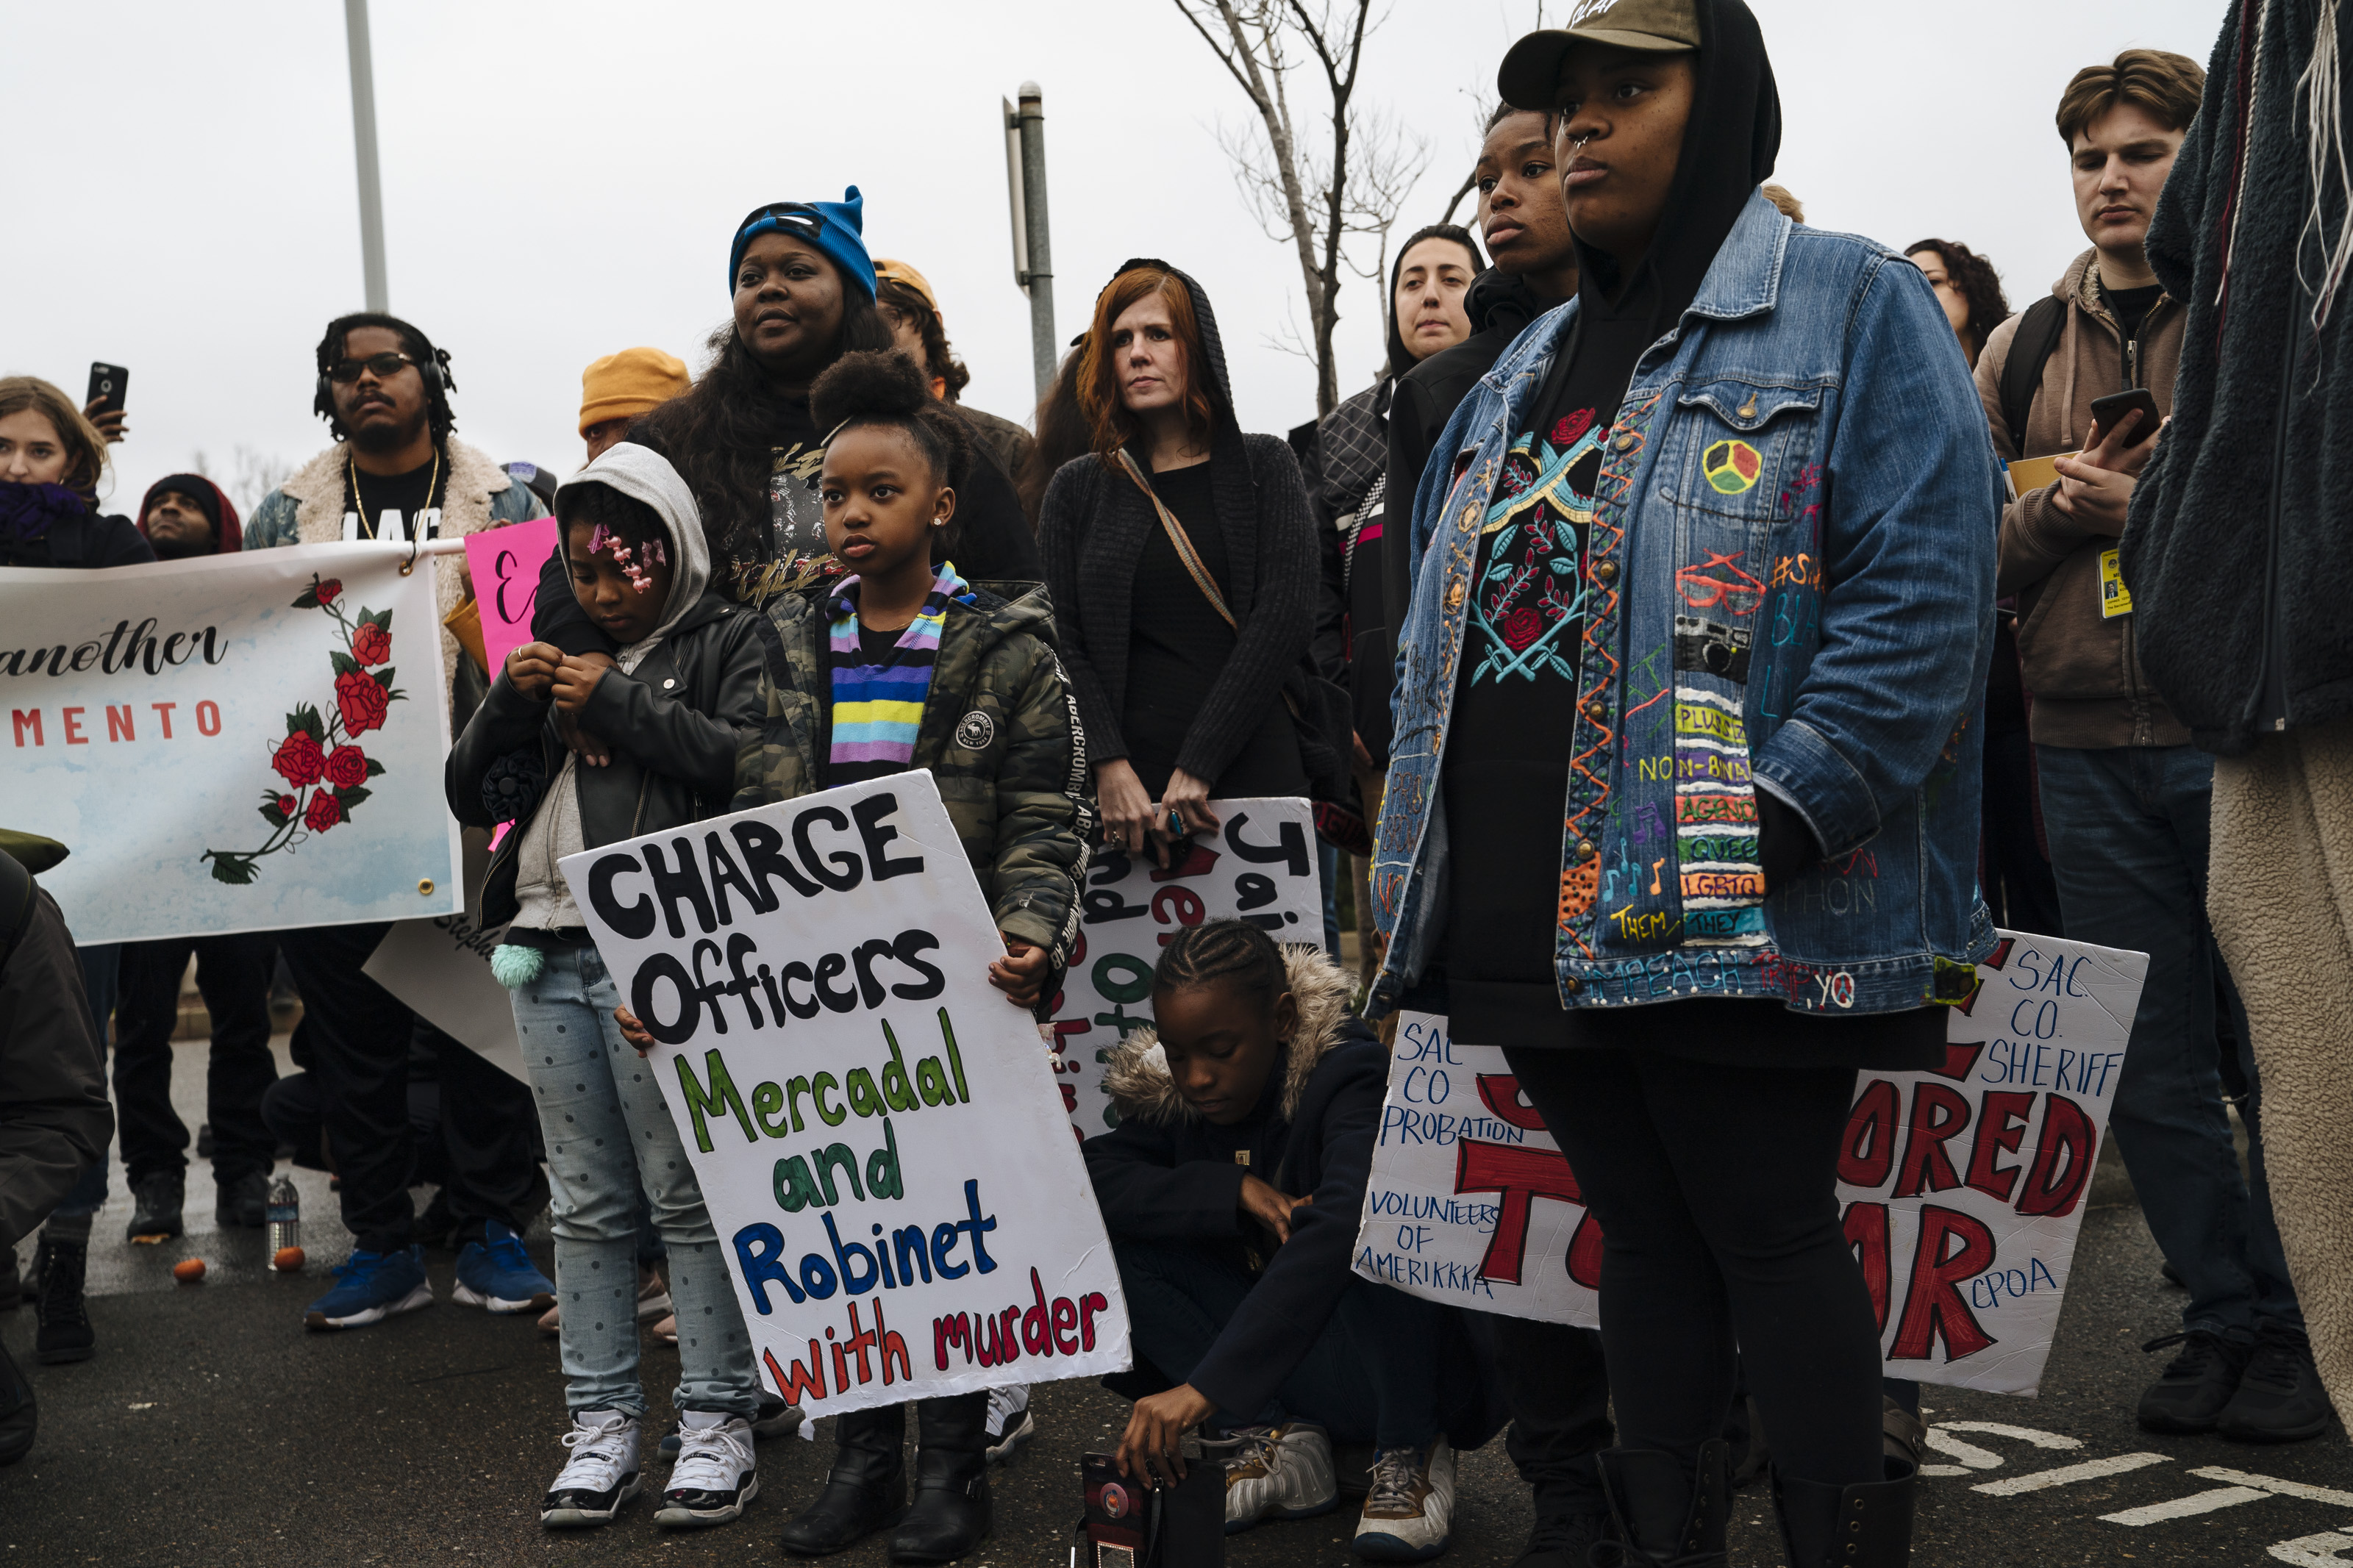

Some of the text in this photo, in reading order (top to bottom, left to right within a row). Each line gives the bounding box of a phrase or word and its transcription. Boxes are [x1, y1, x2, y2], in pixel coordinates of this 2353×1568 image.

[0, 617, 228, 677] another
[12, 700, 222, 748] MENTO
[588, 792, 924, 939] CHARGE
[1224, 812, 1318, 955] Jai
[1685, 875, 1757, 900] LGBTQ
[1610, 904, 1666, 942] THEM
[1689, 911, 1741, 933] THEY
[632, 929, 946, 1045] Officers
[1583, 950, 1744, 1006] IMPEACH
[2011, 999, 2063, 1039] CO.
[674, 1007, 970, 1153] Mercadal
[1404, 1066, 1450, 1104] CO
[1981, 1038, 2124, 1098] SHERIFF
[1380, 1105, 1524, 1146] PROBATION
[772, 1117, 904, 1213] and
[1371, 1191, 1500, 1234] VOLUNTEERS
[1397, 1225, 1434, 1253] OF
[732, 1178, 998, 1316] Robinet
[1355, 1246, 1494, 1300] AMERIKKKA
[1972, 1257, 2057, 1310] CPOA
[763, 1267, 1109, 1407] with murder
